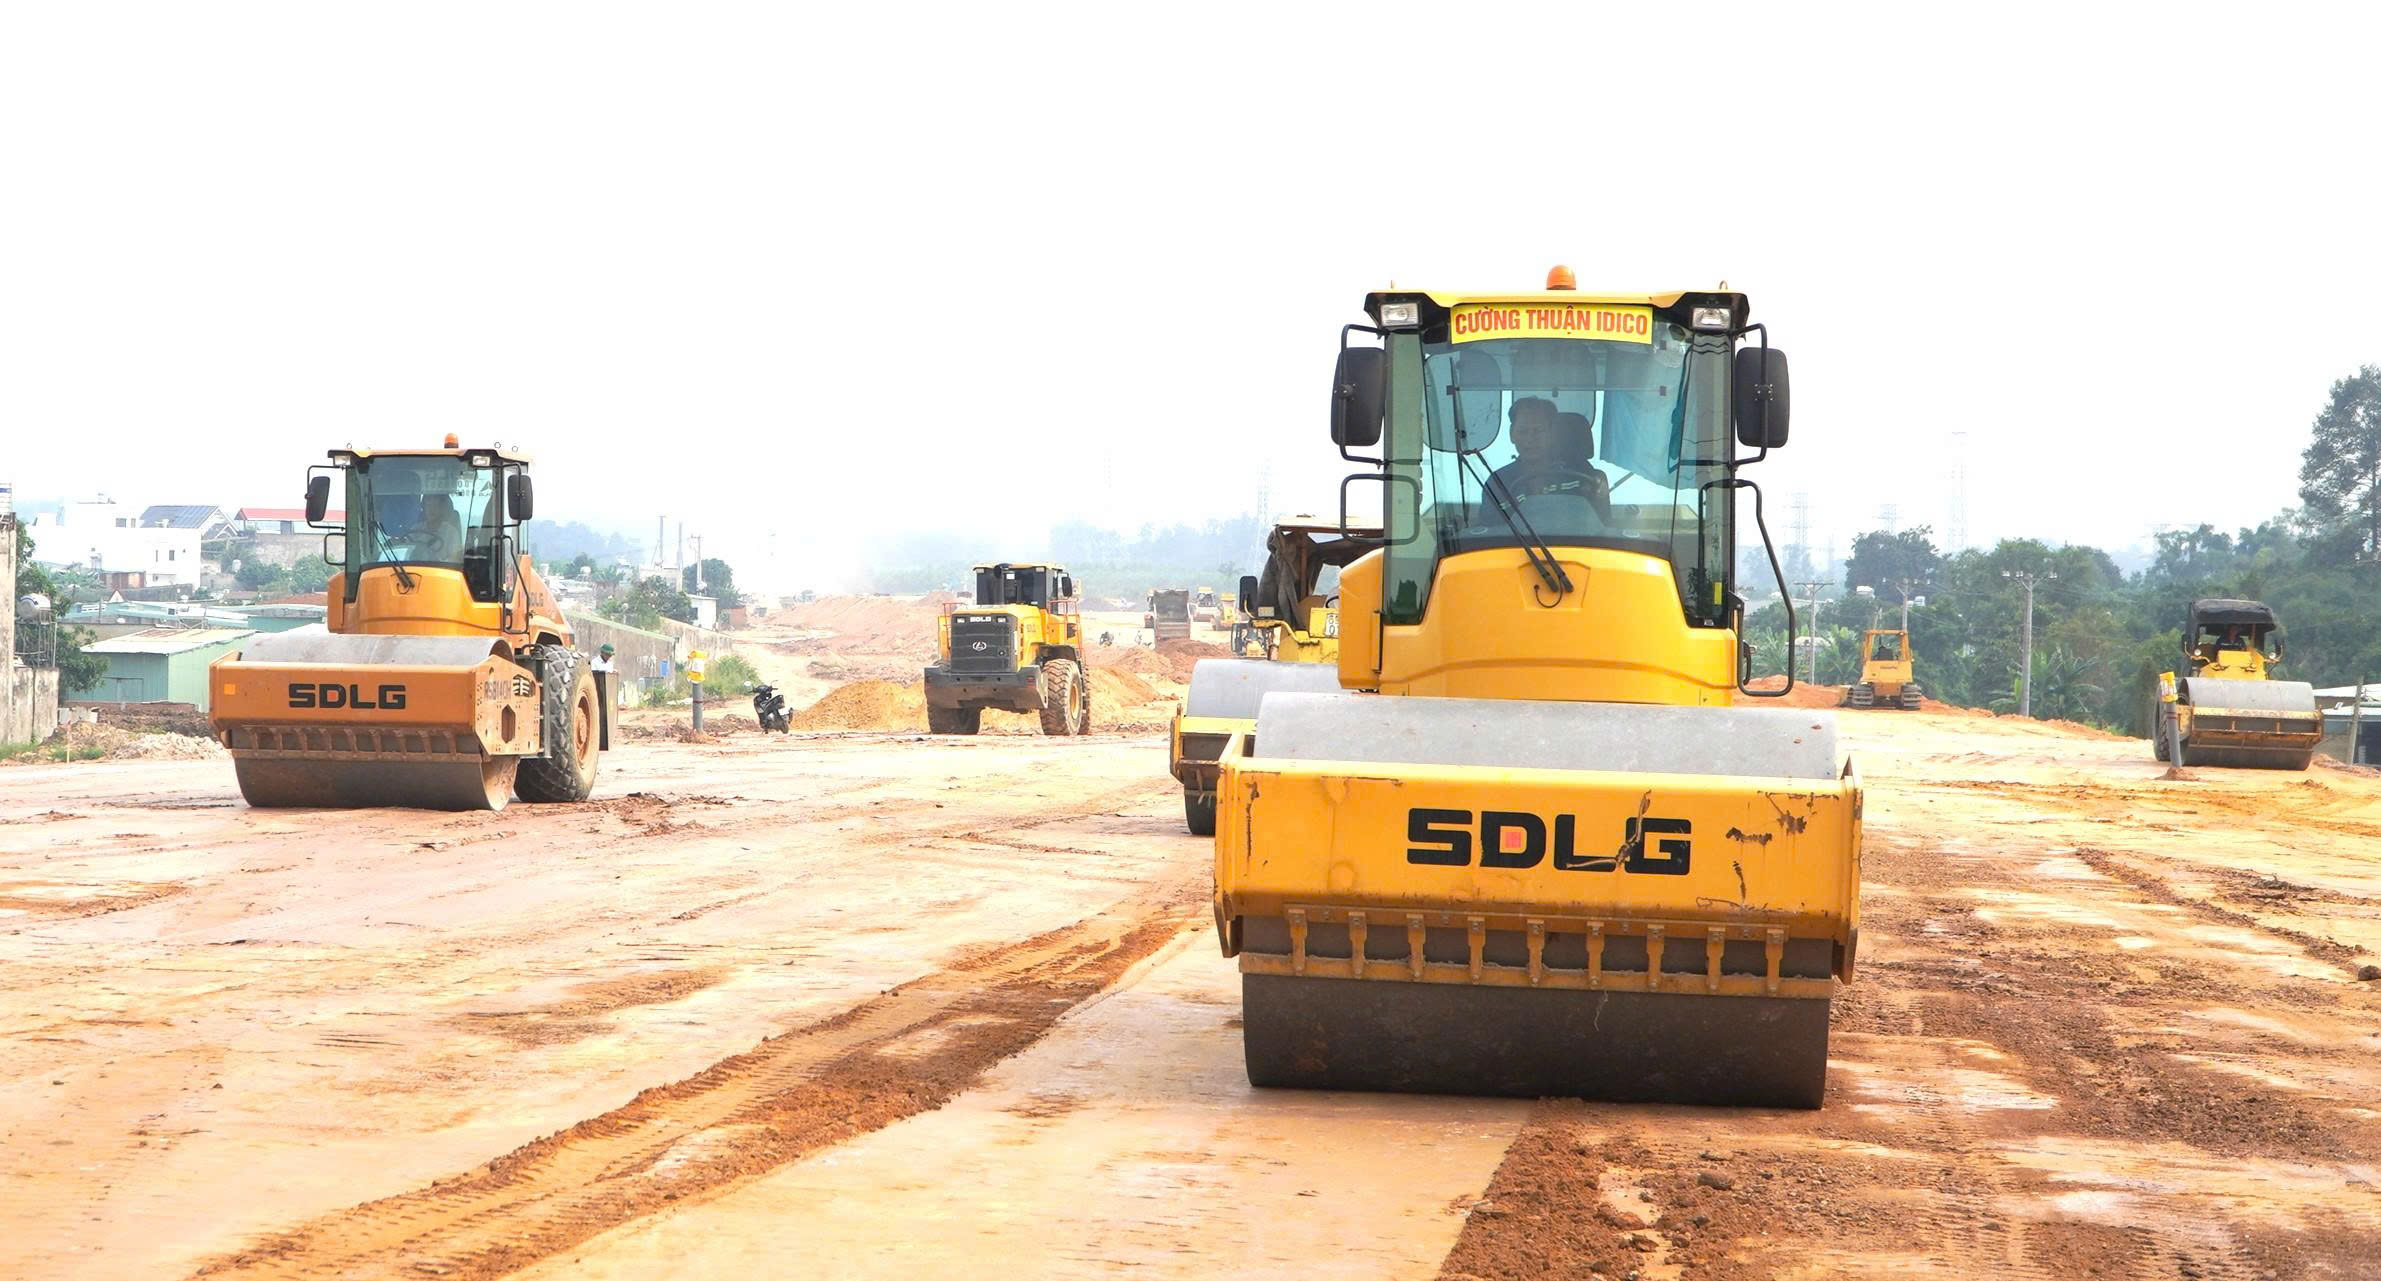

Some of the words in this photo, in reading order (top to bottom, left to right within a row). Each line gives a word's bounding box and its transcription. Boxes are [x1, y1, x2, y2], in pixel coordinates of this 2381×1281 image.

[1455, 306, 1520, 335] CƯỜNG
[1526, 305, 1590, 335] THUẬN
[1597, 311, 1648, 335] IDICO
[288, 683, 406, 710] SDLG
[1406, 807, 1692, 876] SDLG
